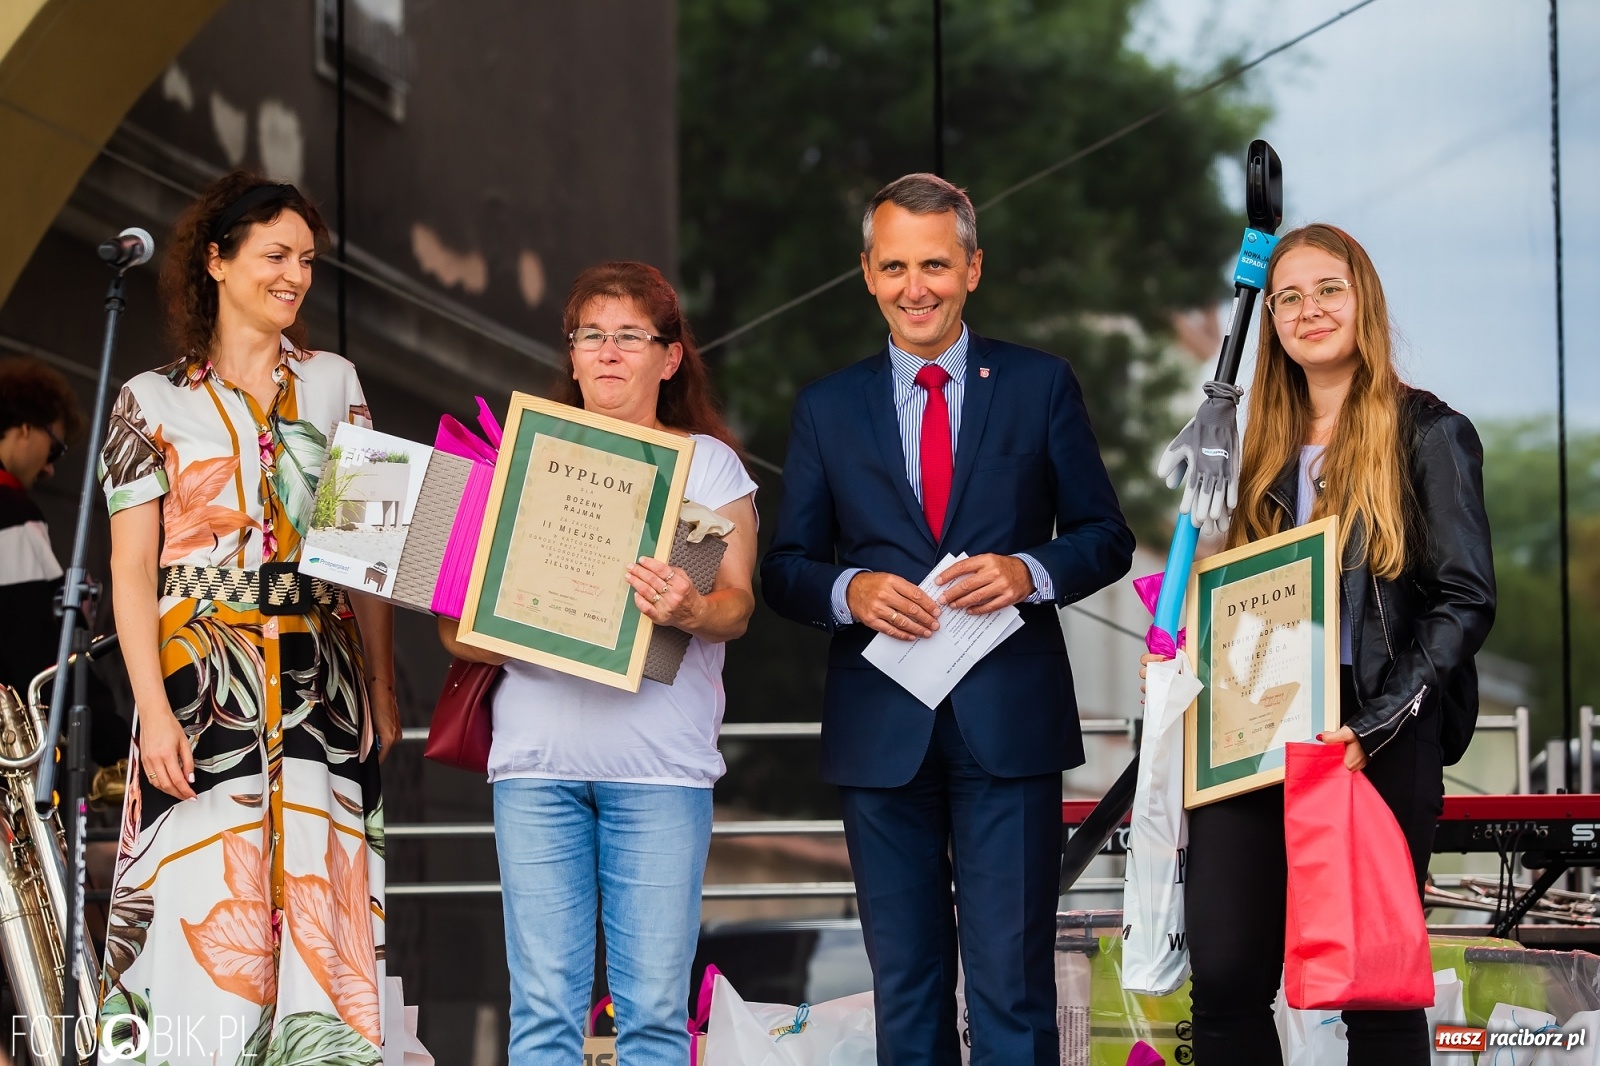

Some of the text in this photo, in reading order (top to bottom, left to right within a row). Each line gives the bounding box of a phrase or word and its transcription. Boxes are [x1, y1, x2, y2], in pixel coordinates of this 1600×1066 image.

[1244, 250, 1260, 260] NOWA
[548, 460, 633, 494] DYPLOM
[564, 504, 601, 520] RAJMAN
[542, 520, 612, 546] II MIEJSCA
[562, 536, 599, 550] KATEGORII
[544, 559, 580, 573] ZIELONO
[557, 556, 594, 569] KONKURSIE
[1228, 584, 1296, 617] DYPLOM
[1245, 644, 1287, 662] MIEJSCA
